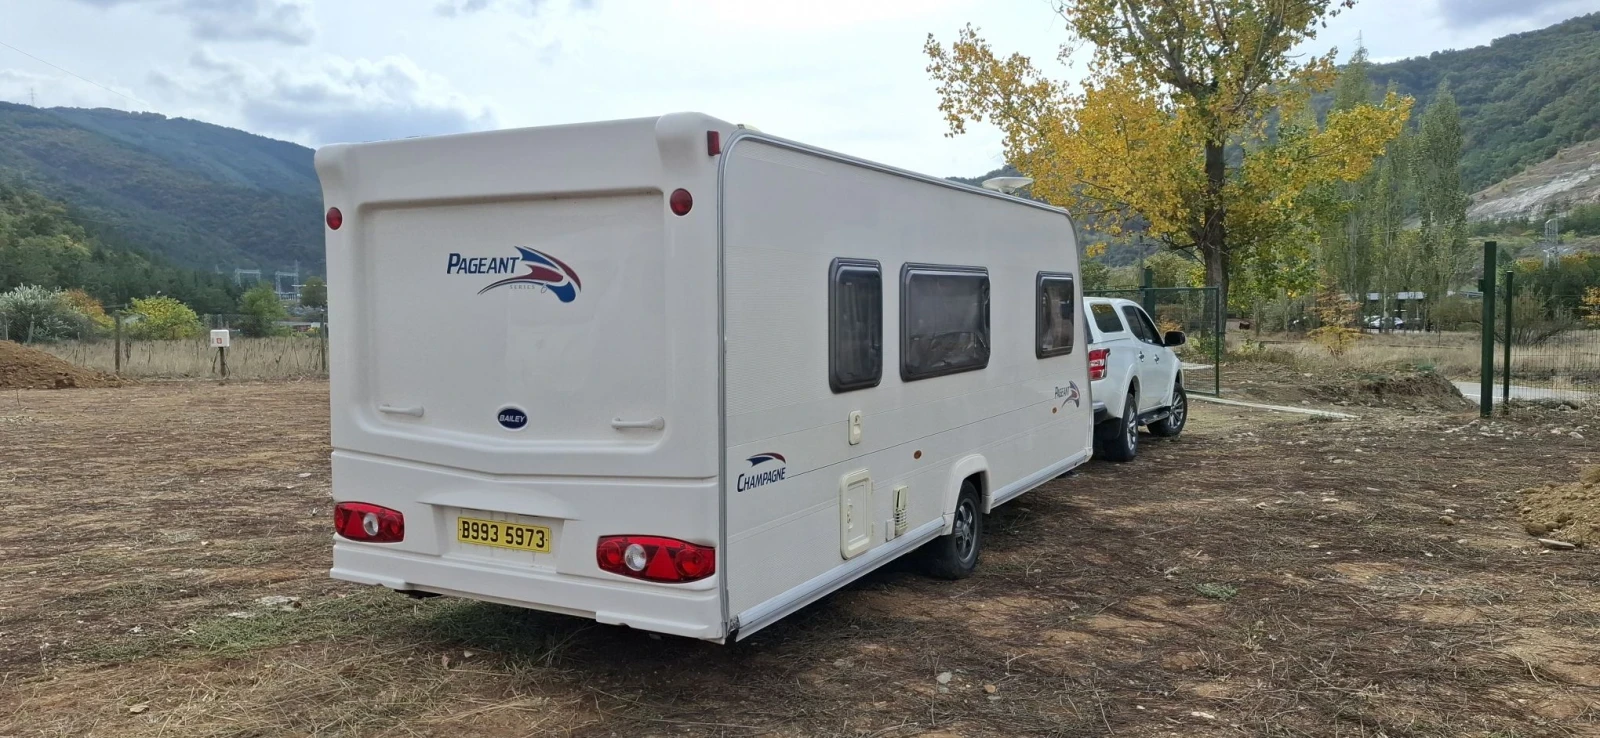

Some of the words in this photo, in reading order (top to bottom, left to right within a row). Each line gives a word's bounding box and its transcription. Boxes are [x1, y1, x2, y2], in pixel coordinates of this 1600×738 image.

[447, 253, 520, 274] PAGEANT
[499, 414, 525, 423] BAILEY
[737, 467, 786, 492] CHAMPAGNE
[461, 520, 499, 543] B993
[505, 525, 545, 548] 5973
